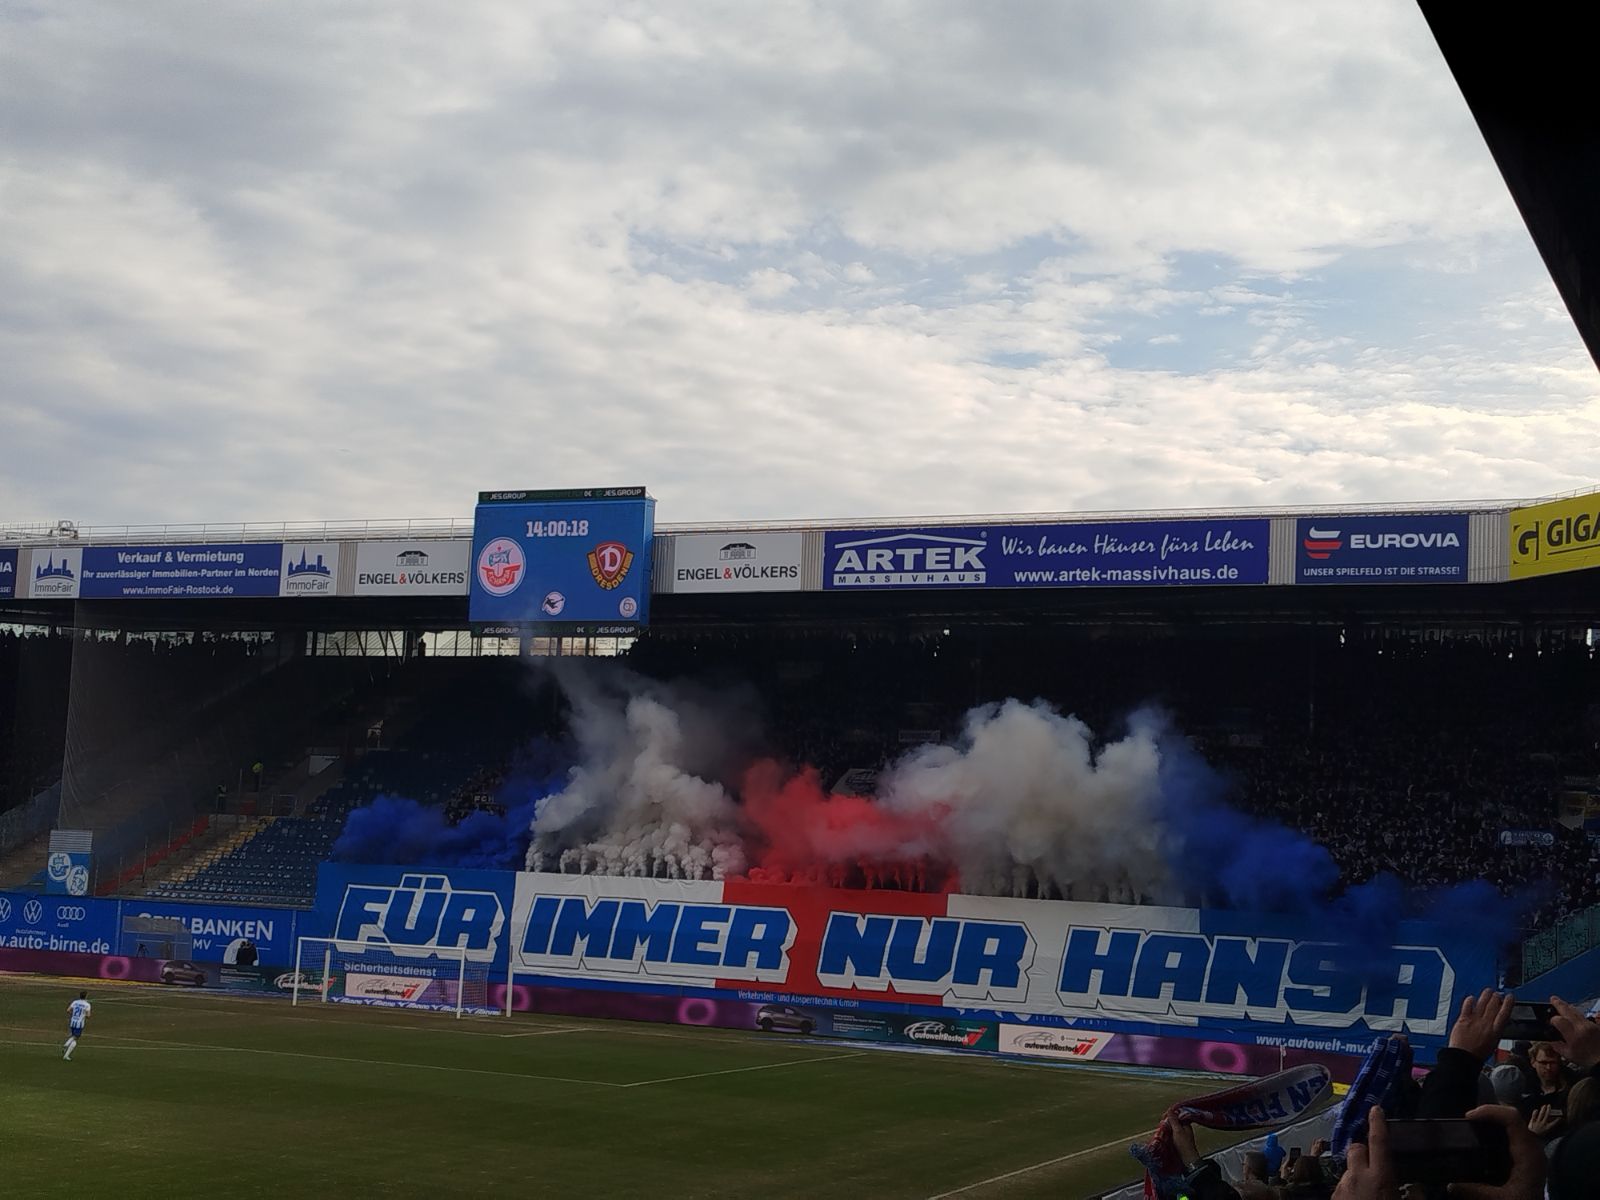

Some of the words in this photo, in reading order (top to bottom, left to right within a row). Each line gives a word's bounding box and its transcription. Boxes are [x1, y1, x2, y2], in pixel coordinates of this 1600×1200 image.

[603, 489, 642, 497] JES.GROUP
[526, 520, 589, 537] 14:00:18
[1001, 535, 1034, 556] Wir
[1038, 535, 1088, 556] bauen
[1094, 533, 1155, 555] Häuser
[1160, 532, 1198, 560] fürs
[1204, 530, 1254, 552] Leben
[1350, 533, 1460, 549] EUROVIA
[118, 552, 162, 563] Verkauf
[164, 551, 173, 562] &
[177, 550, 244, 564] Vermietung
[834, 547, 986, 571] ARTEK
[83, 570, 94, 578] Ihr
[96, 569, 150, 580] zuverlässiger
[152, 568, 233, 578] Immobilien-Partner
[247, 568, 279, 577] Norden
[838, 573, 981, 583] MASSIVHAUS
[1014, 565, 1239, 582] www.artek-massivhaus.de
[1304, 568, 1334, 576] UNSER
[1336, 567, 1382, 576] SPIELFELD
[1384, 567, 1398, 575] IST
[1400, 567, 1415, 575] DIE
[1417, 566, 1460, 575] STRASSE!
[286, 579, 330, 590] ImmoFair
[592, 567, 628, 590] DRESDEN
[35, 583, 73, 593] ImmoFair
[193, 938, 212, 951] MV
[335, 873, 505, 963] FÜR
[519, 894, 798, 984] IMMER
[816, 911, 1038, 1004] NUR
[1055, 924, 1456, 1036] HANSA
[344, 962, 437, 977] Sicherheitsdienst
